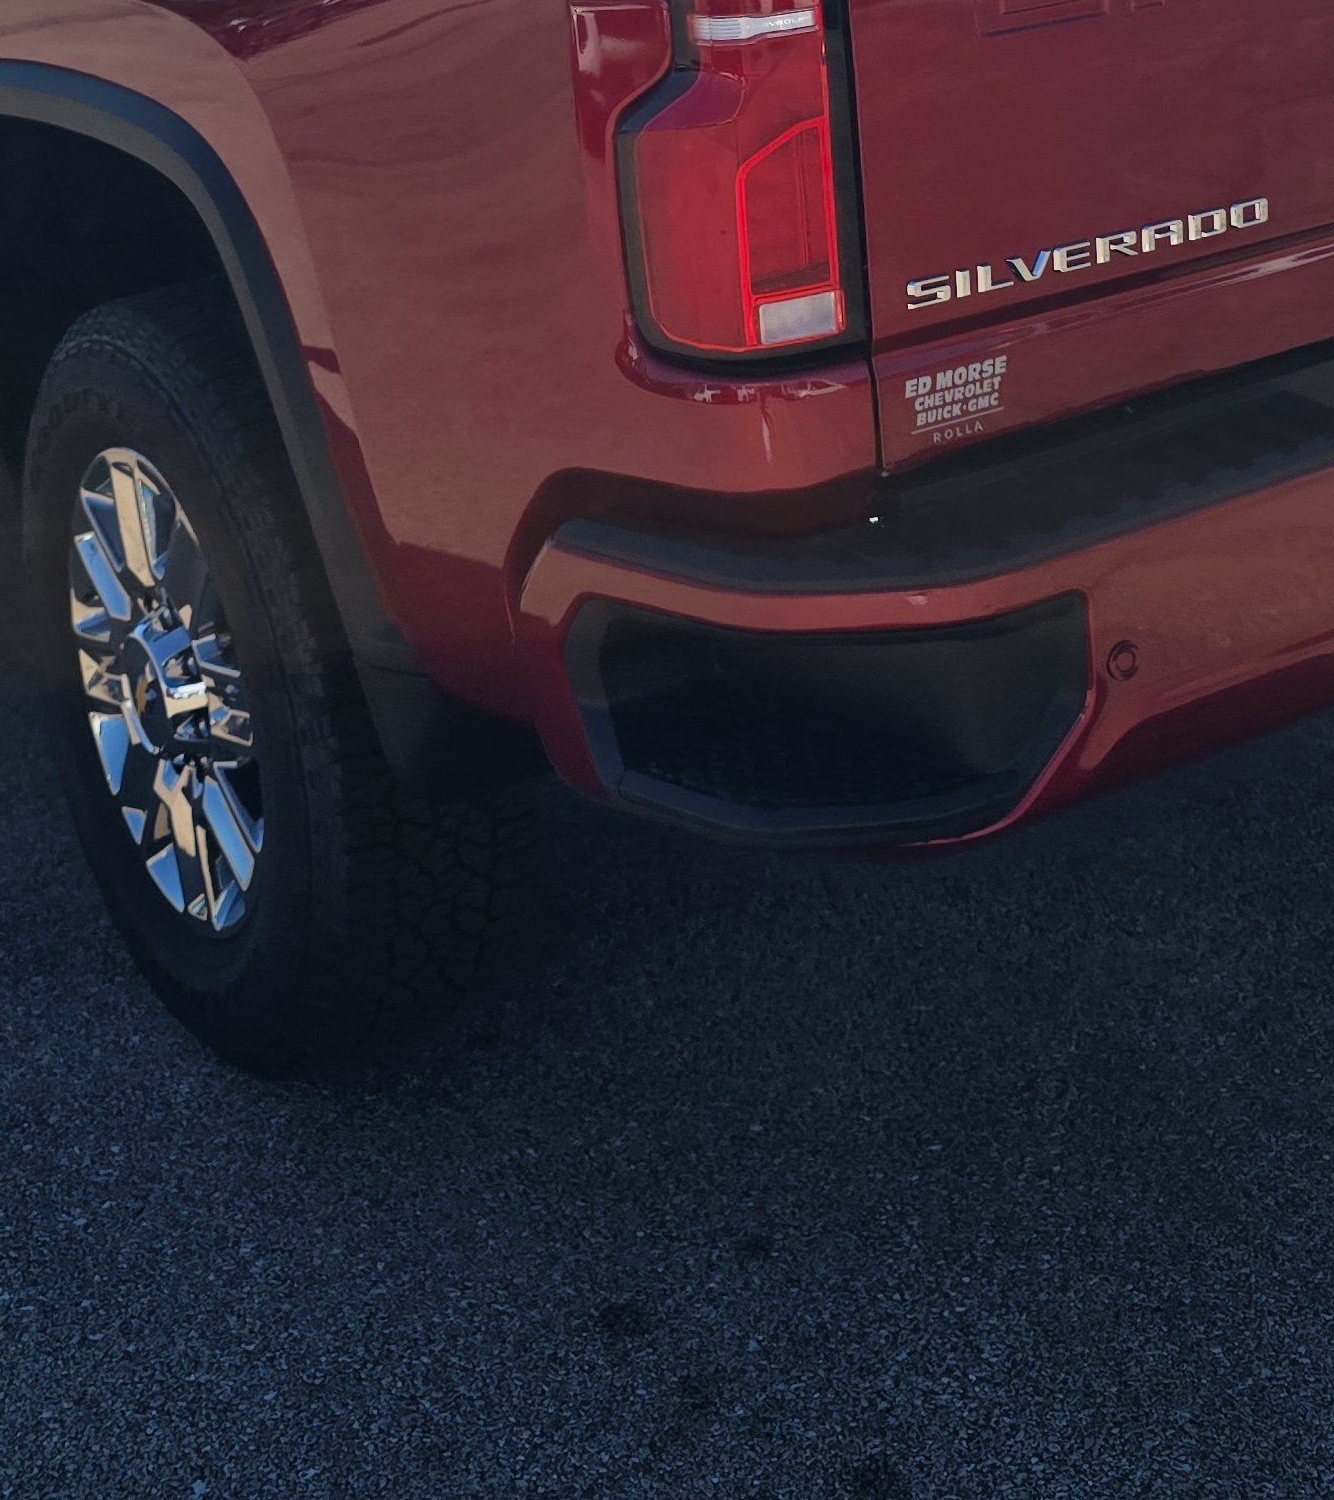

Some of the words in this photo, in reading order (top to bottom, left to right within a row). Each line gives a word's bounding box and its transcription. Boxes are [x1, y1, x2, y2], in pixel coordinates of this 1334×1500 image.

[907, 197, 1269, 310] SILVERADO
[905, 375, 932, 399] ED
[936, 355, 1007, 390] MORSE
[914, 376, 1002, 411] CHEVROLET
[933, 421, 984, 443] ROLLA
